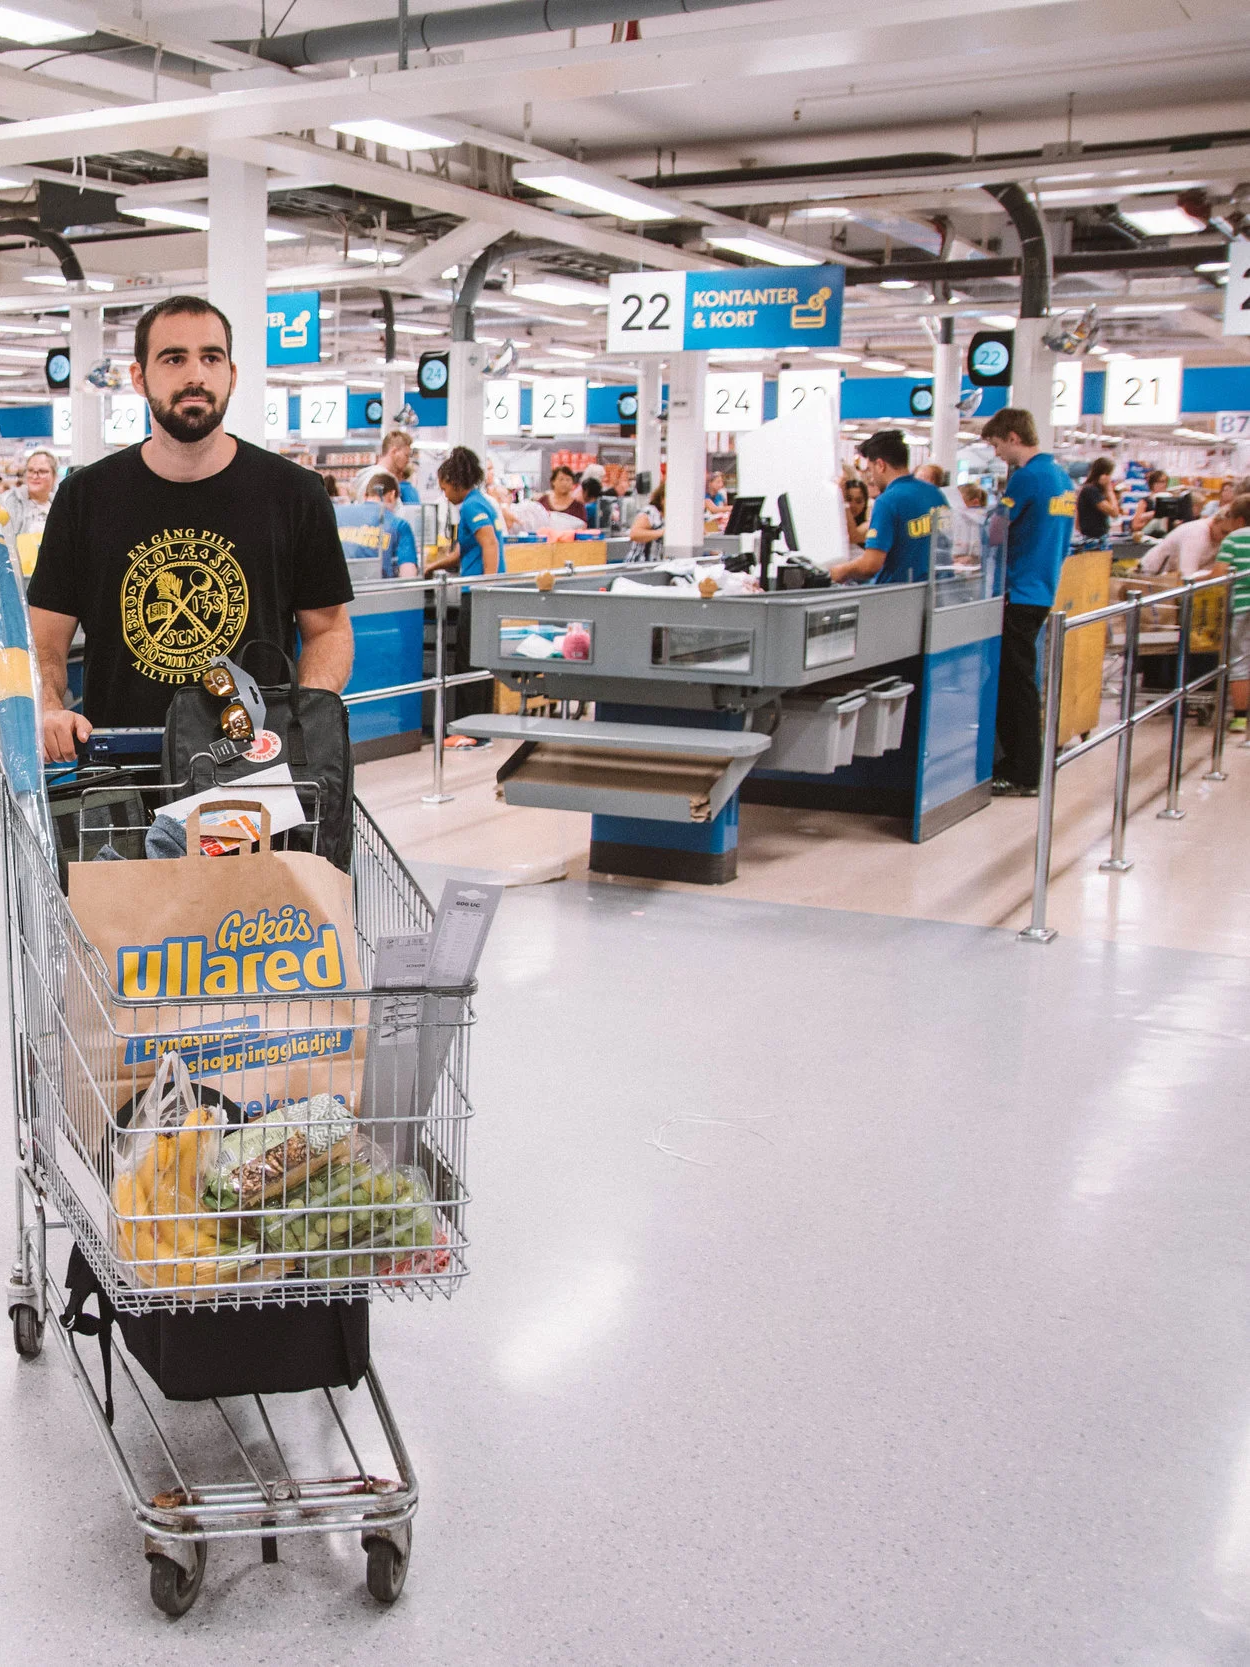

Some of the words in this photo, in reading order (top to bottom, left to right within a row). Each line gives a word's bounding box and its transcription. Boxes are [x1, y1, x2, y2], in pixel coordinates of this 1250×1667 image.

[692, 287, 799, 308] KONTANTER
[621, 293, 671, 331] 22
[692, 311, 706, 329] &
[709, 310, 758, 328] KORT
[979, 350, 1001, 366] 22
[426, 366, 442, 383] 24
[715, 388, 750, 415] 24
[1052, 378, 1068, 407] 2
[1123, 376, 1161, 406] 21
[310, 400, 337, 424] 27
[543, 393, 575, 419] 25
[111, 408, 138, 431] 29
[126, 541, 148, 561] EN
[151, 528, 196, 545] GÅNG
[201, 529, 236, 552] PILT
[162, 627, 199, 646] SCN
[132, 660, 186, 685] ALLTID
[217, 907, 313, 952] Gekås
